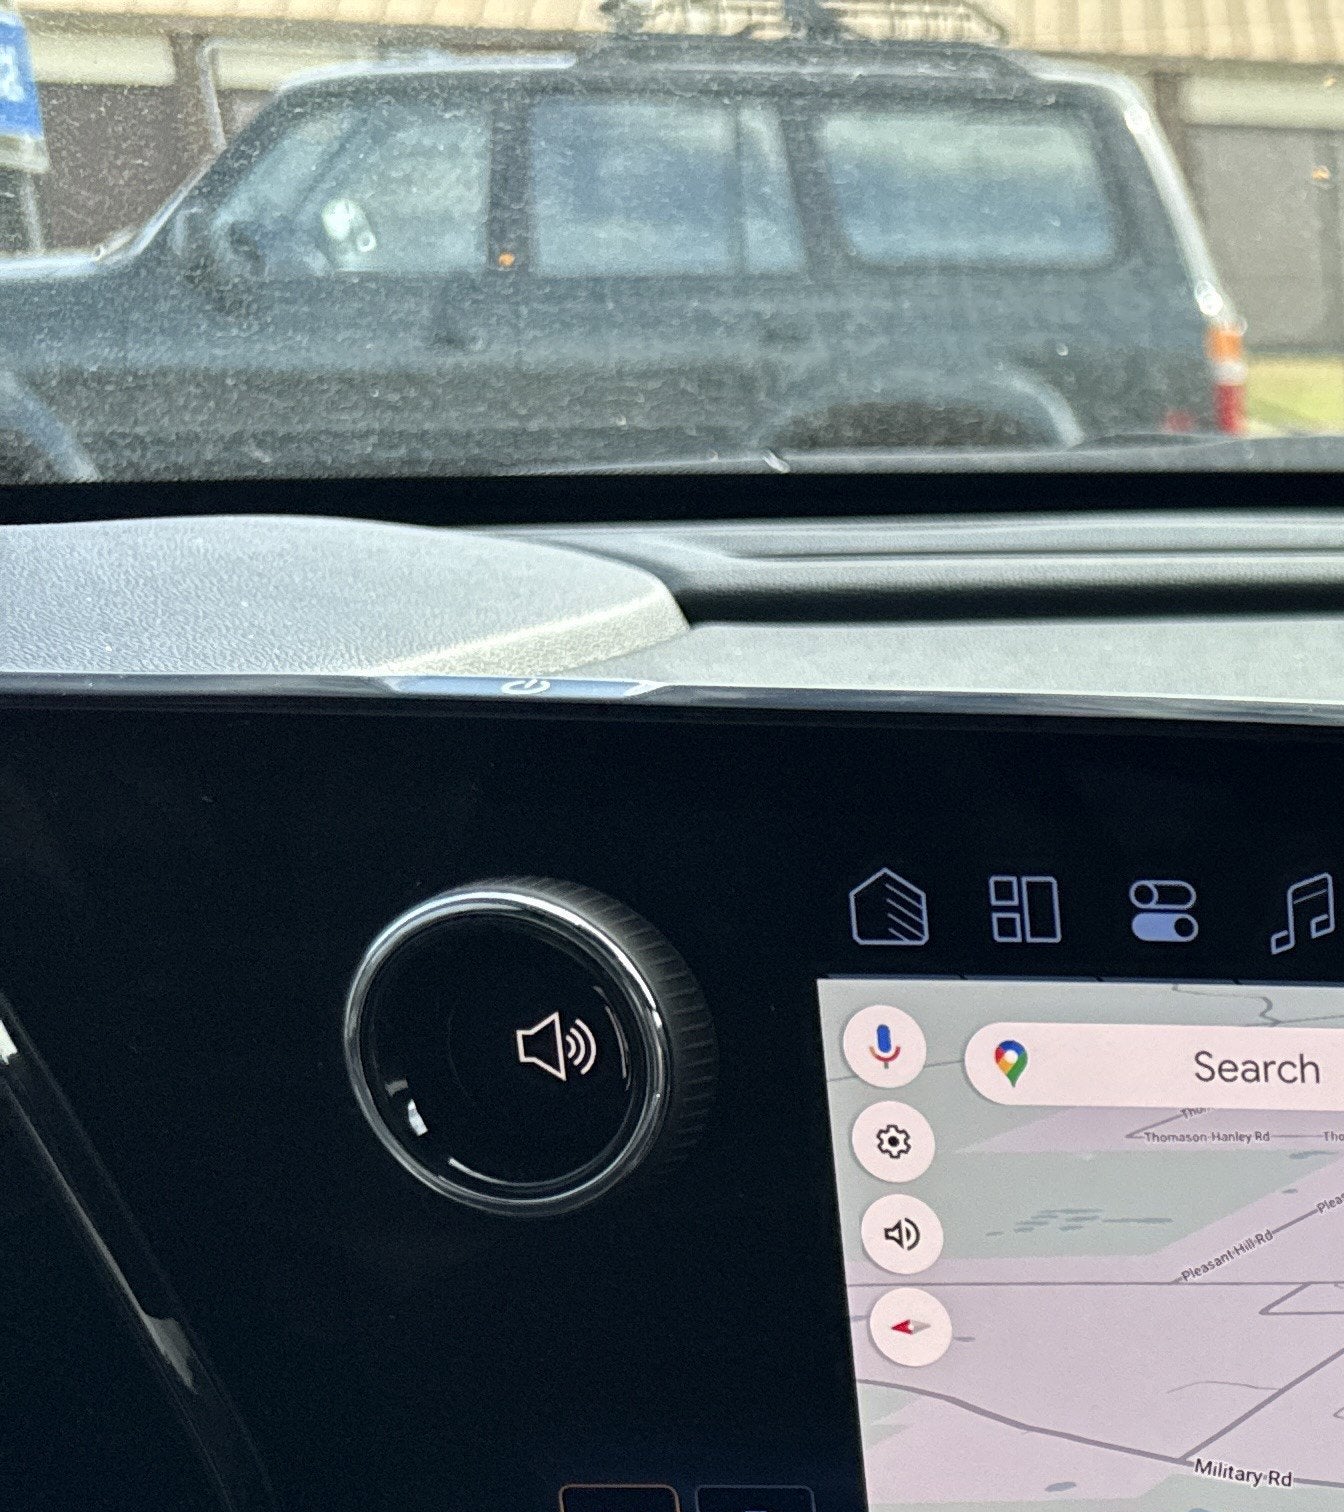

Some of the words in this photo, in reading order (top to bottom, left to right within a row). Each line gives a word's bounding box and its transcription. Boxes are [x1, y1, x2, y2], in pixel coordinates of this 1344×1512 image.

[1194, 1050, 1321, 1084] Search
[1144, 1131, 1206, 1143] Thomason
[1254, 1130, 1270, 1142] Rd
[1181, 1247, 1234, 1281] Pleasant
[1232, 1237, 1256, 1259] Hill
[1255, 1229, 1274, 1246] Rd
[1194, 1458, 1263, 1488] Military
[1269, 1469, 1293, 1487] Rd
